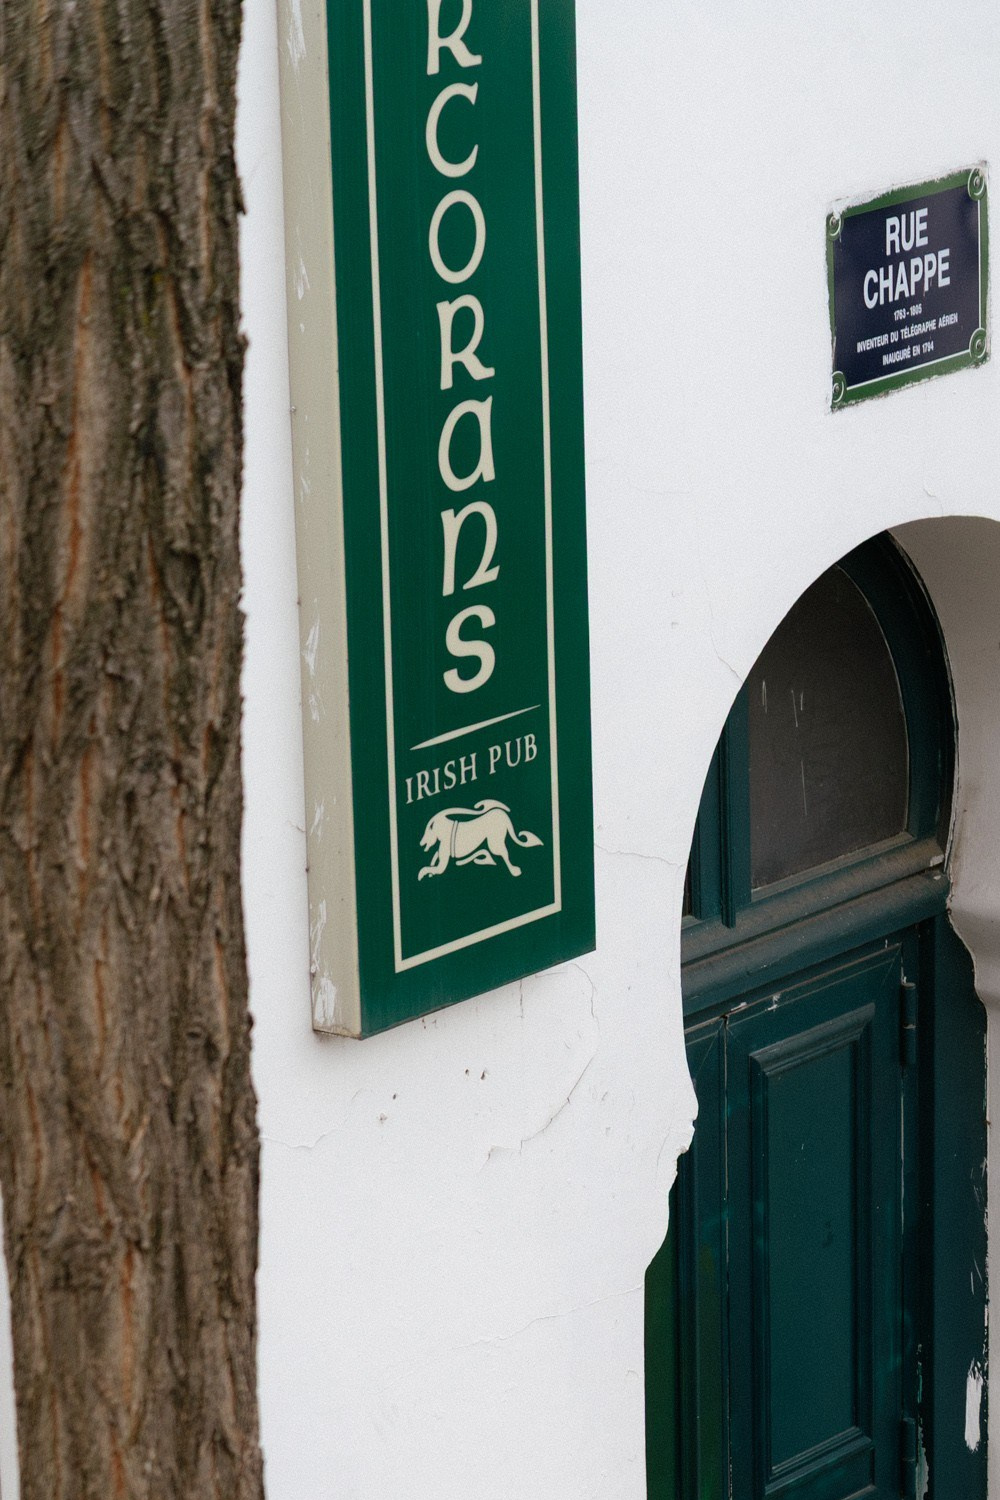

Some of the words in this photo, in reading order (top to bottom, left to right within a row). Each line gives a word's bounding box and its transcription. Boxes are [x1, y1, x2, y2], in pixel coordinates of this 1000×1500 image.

[885, 207, 929, 256] RUE
[863, 248, 951, 309] CHAPPE
[857, 333, 889, 353] INVENTEUR
[890, 331, 899, 344] DU
[900, 319, 937, 339] TÉLÉGRAPHE
[938, 312, 959, 328] AÉRIEN
[882, 345, 911, 366] INAUGURÉ
[912, 344, 921, 357] EN
[922, 340, 935, 354] 1794
[405, 752, 478, 805] IRISH
[488, 732, 539, 775] PUB
